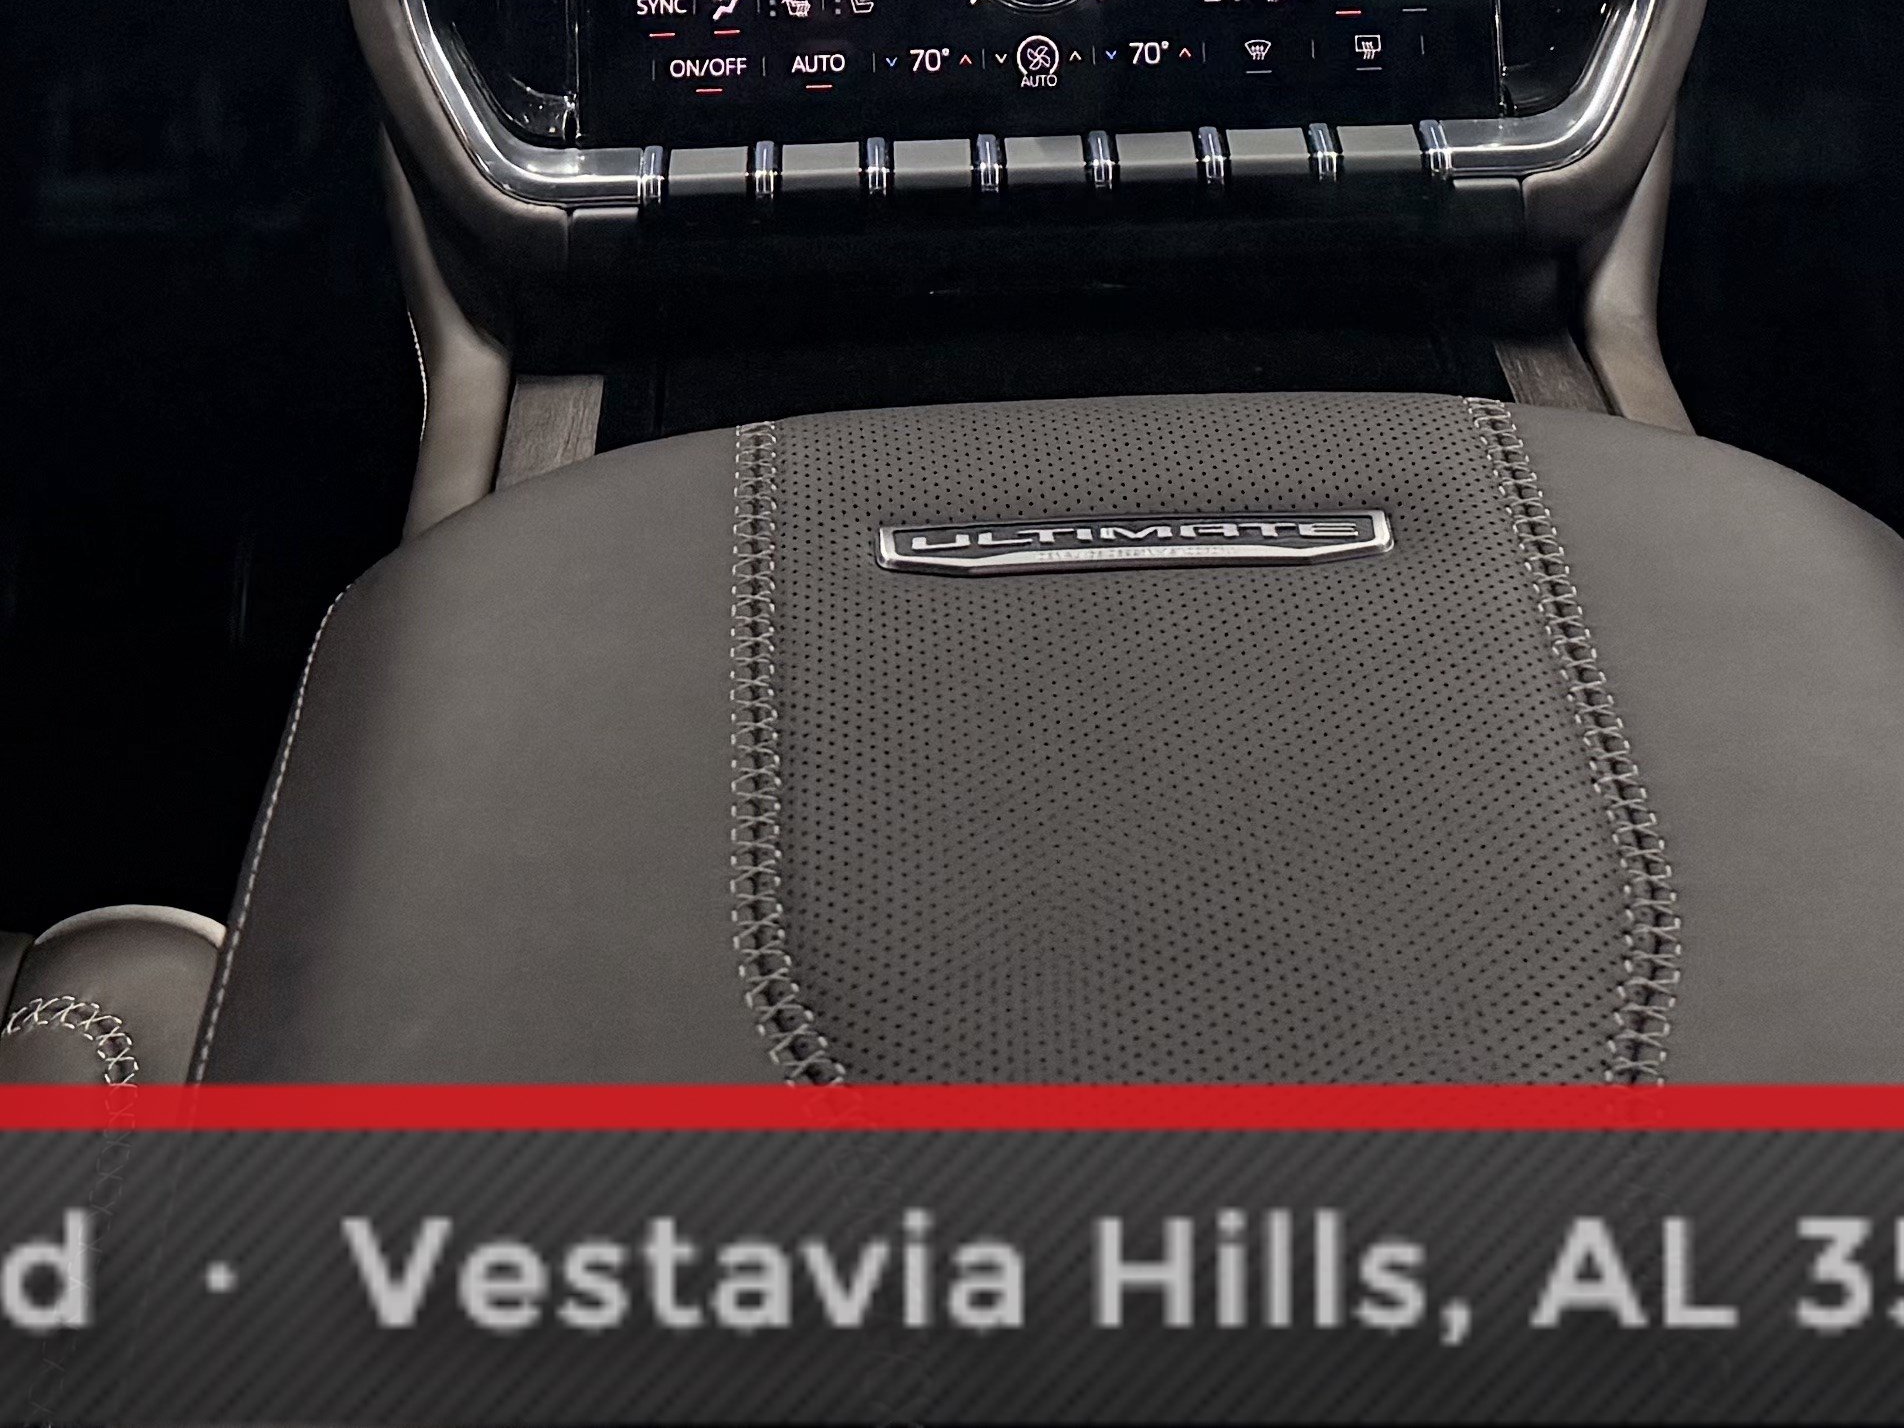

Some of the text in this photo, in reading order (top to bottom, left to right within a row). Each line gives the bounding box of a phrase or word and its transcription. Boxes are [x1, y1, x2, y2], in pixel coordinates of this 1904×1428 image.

[790, 54, 846, 74] AUTO
[909, 47, 950, 72] 70°
[1128, 40, 1170, 65] 70°
[669, 57, 747, 78] ON/OFF
[1020, 74, 1058, 88] AUTO
[910, 521, 1361, 552] ULTIMATE
